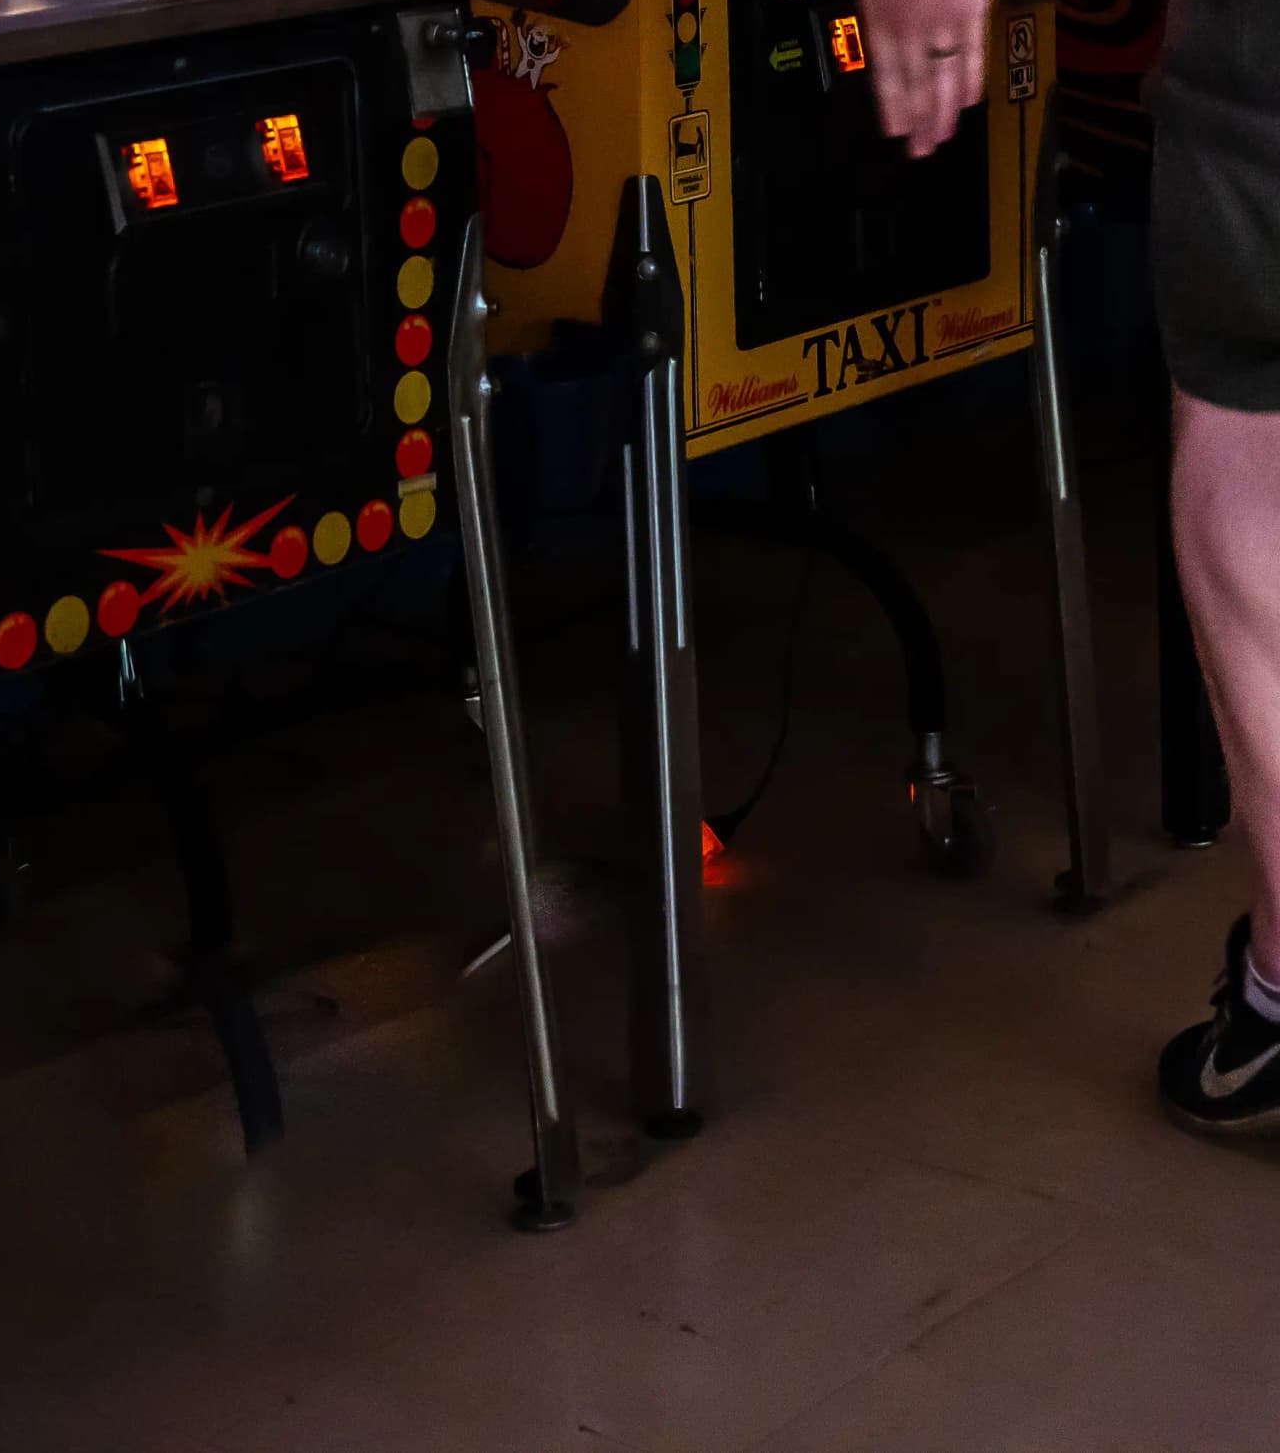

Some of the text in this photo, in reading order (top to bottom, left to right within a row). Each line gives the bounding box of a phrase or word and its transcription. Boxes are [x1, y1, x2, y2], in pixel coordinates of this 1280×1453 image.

[936, 305, 1014, 346] Williams
[802, 302, 930, 398] TAXI
[707, 371, 799, 418] Williams
